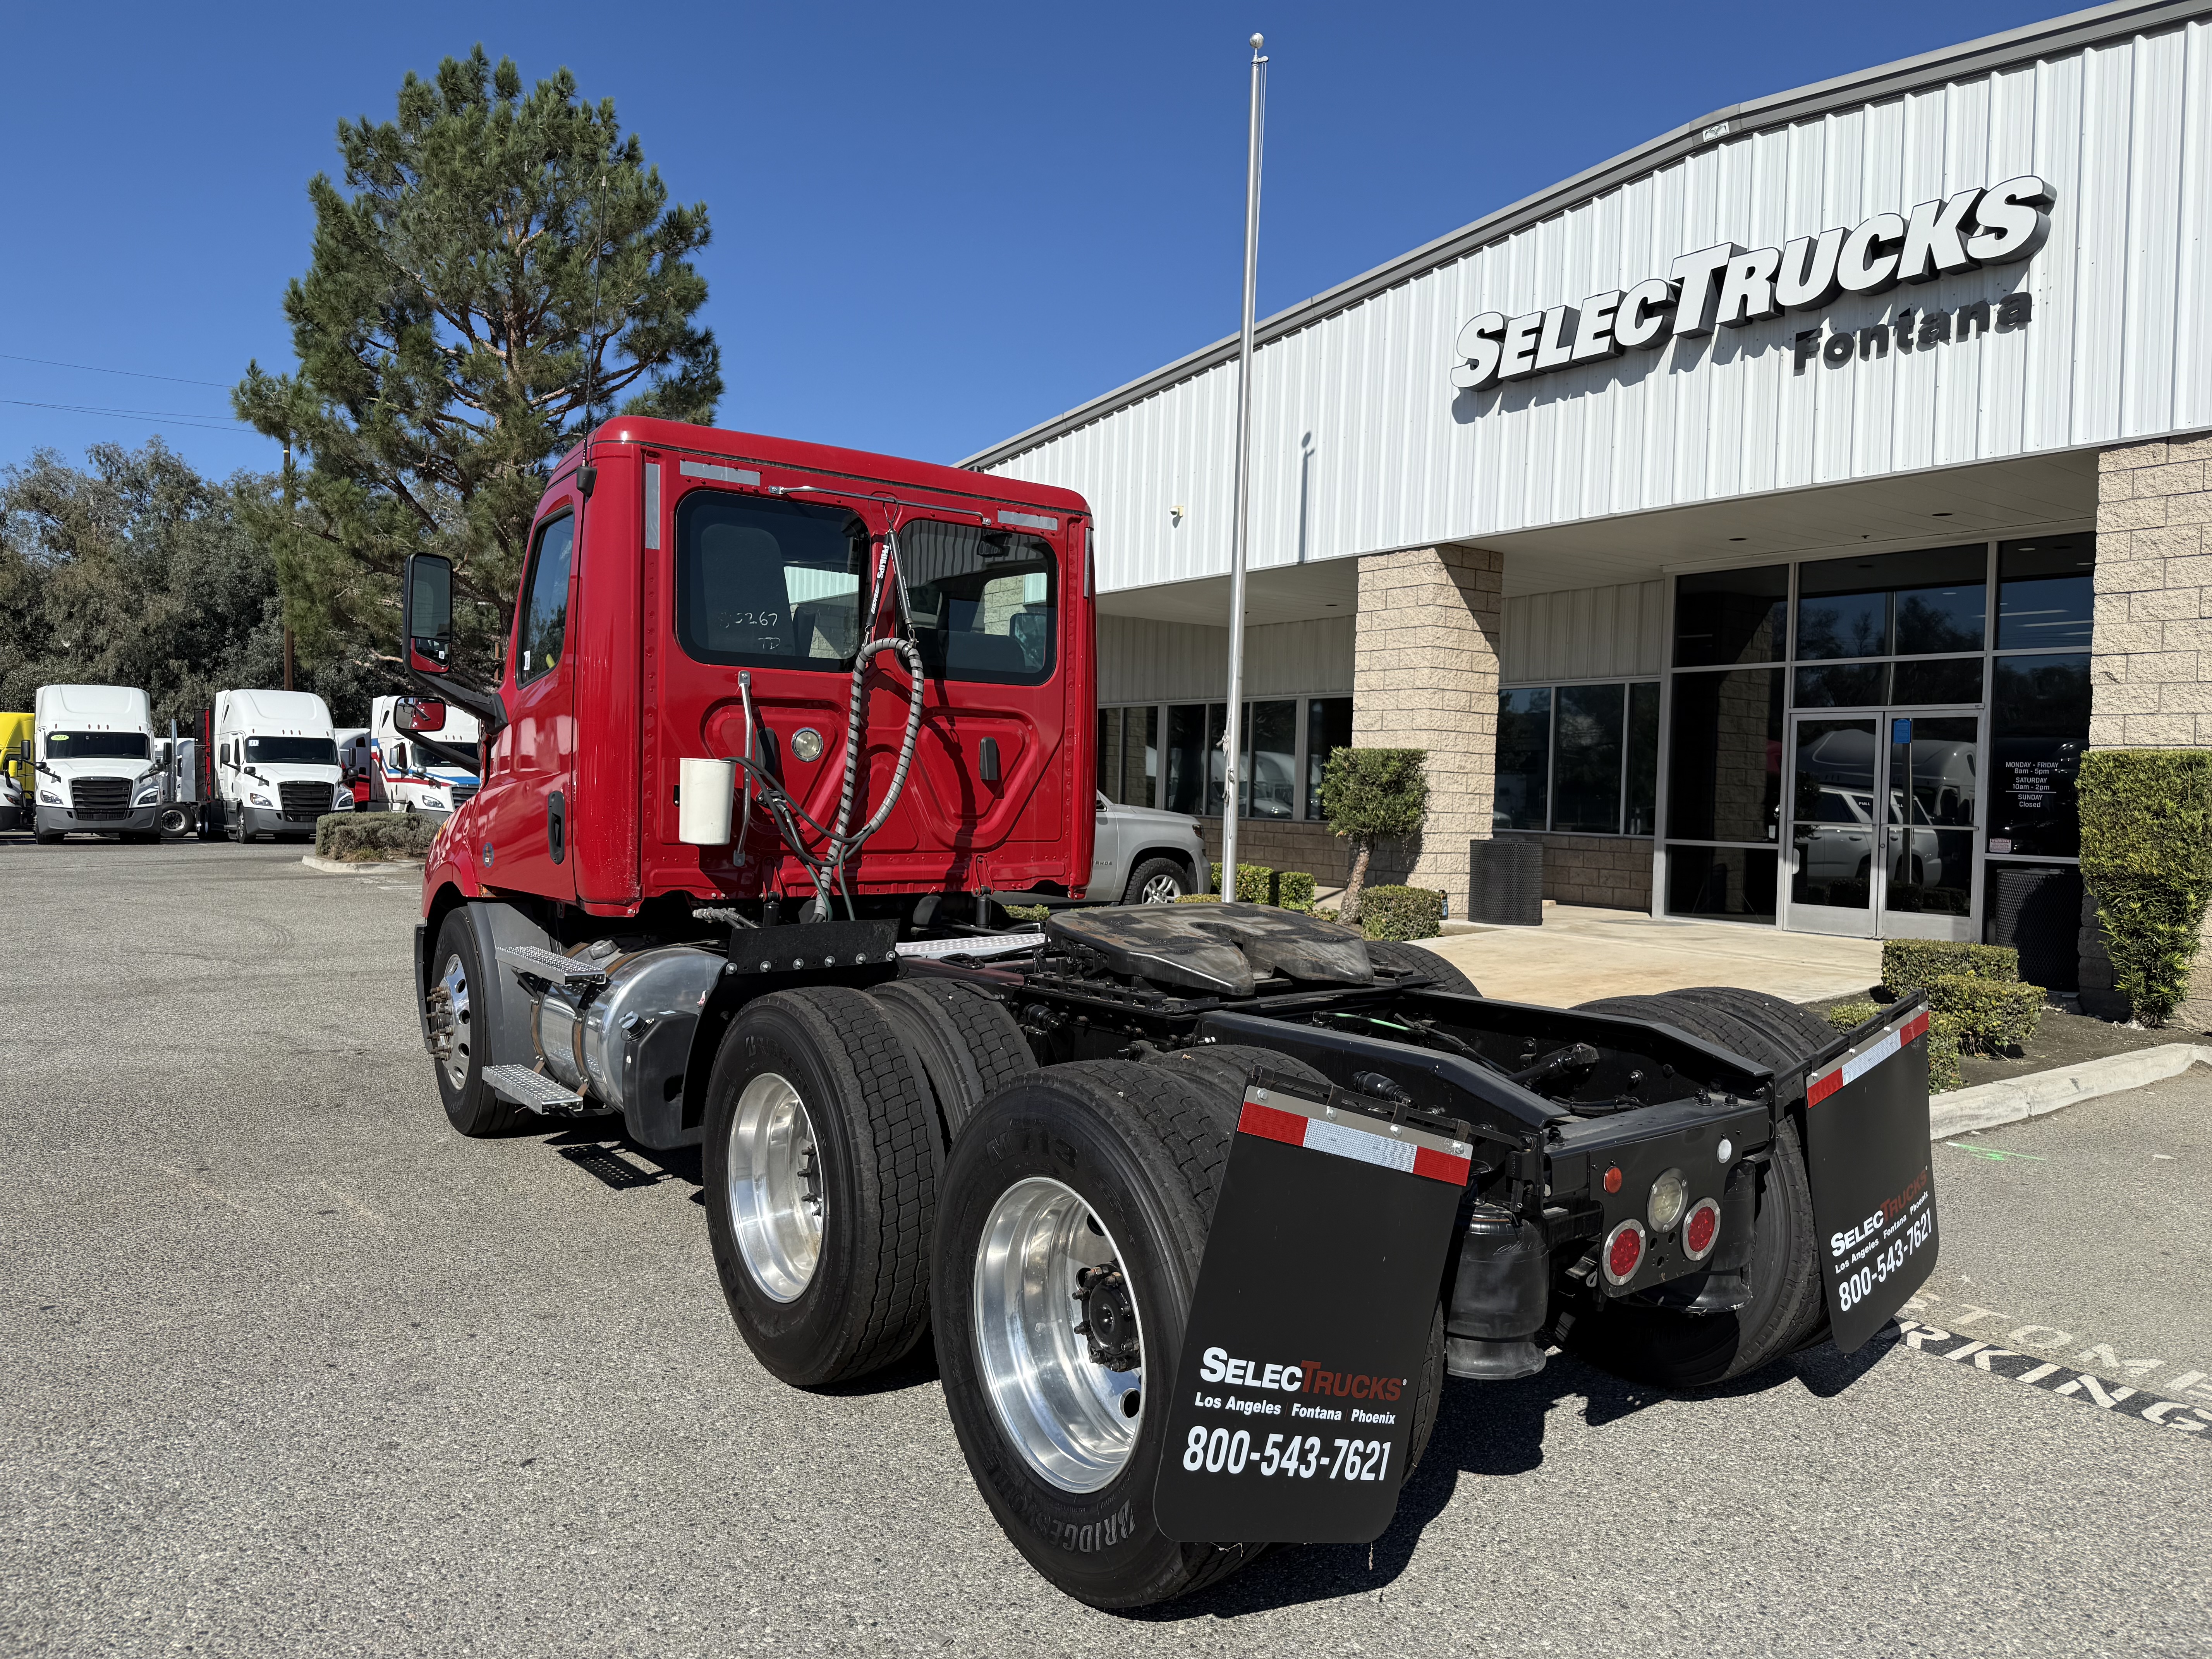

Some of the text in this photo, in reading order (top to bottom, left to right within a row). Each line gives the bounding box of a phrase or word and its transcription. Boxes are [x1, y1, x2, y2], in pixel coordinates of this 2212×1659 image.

[1450, 175, 2056, 392] SELECTRUCKS
[1794, 292, 2032, 371] Fontana
[877, 544, 889, 579] PHILLIPS
[1835, 1190, 1929, 1274] Los Angeles Fontana Phoenix
[1839, 1207, 1932, 1312] 800-543-7621
[1195, 1392, 1396, 1425] Los Angeles Fontana Phoenix
[1876, 1320, 2212, 1432] RKING
[1183, 1425, 1391, 1481] 800-543-7621
